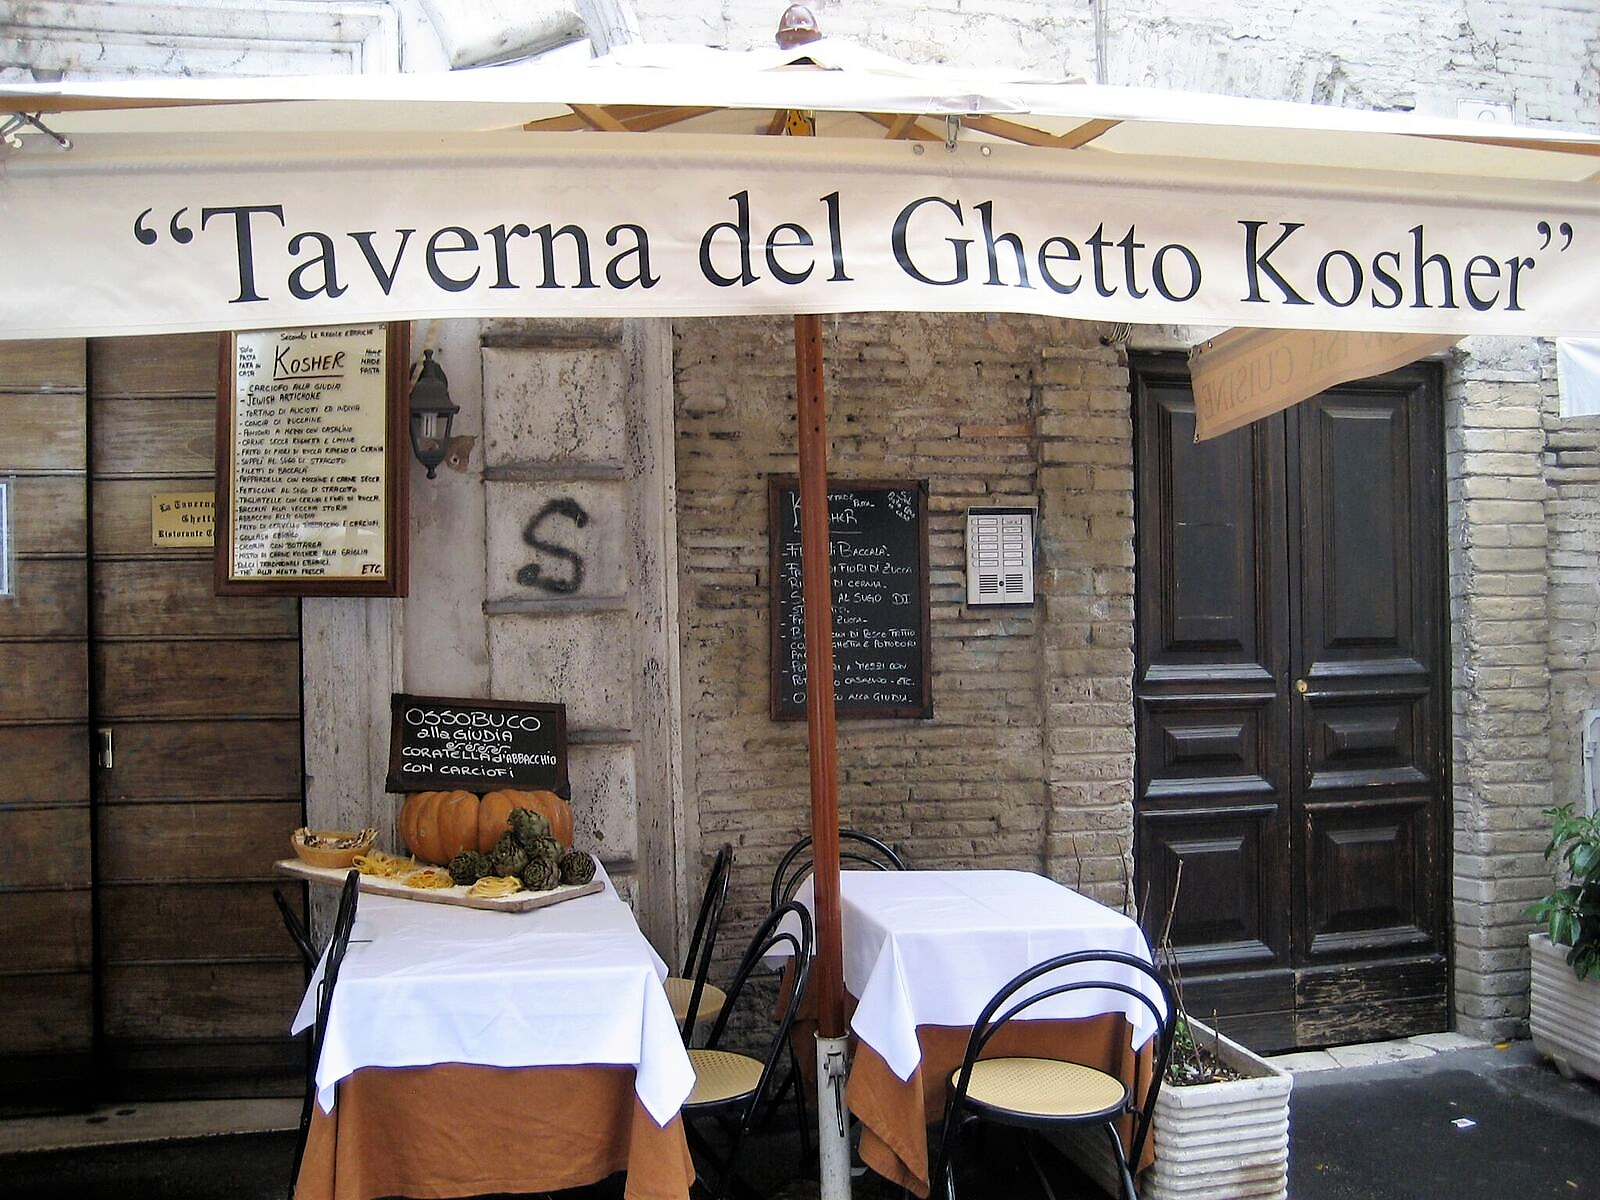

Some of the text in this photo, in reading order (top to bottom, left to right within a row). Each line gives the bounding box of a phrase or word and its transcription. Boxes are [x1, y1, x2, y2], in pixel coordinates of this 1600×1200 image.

[699, 190, 853, 288] del
[892, 196, 1201, 302] Ghetto
[273, 345, 346, 378] KOSHER
[292, 382, 311, 391] ALLA
[246, 391, 321, 407] JEWISH ARTICHOKE
[246, 408, 276, 418] TORTINO
[305, 426, 319, 434] CON
[833, 579, 844, 587] DI
[838, 592, 912, 605] AL SUGO DI
[889, 662, 908, 670] CON
[405, 707, 542, 732] OSSOBUCO
[416, 726, 450, 740] alla
[402, 746, 491, 762] CORATELLA
[402, 762, 515, 778] CON CARCIOFI
